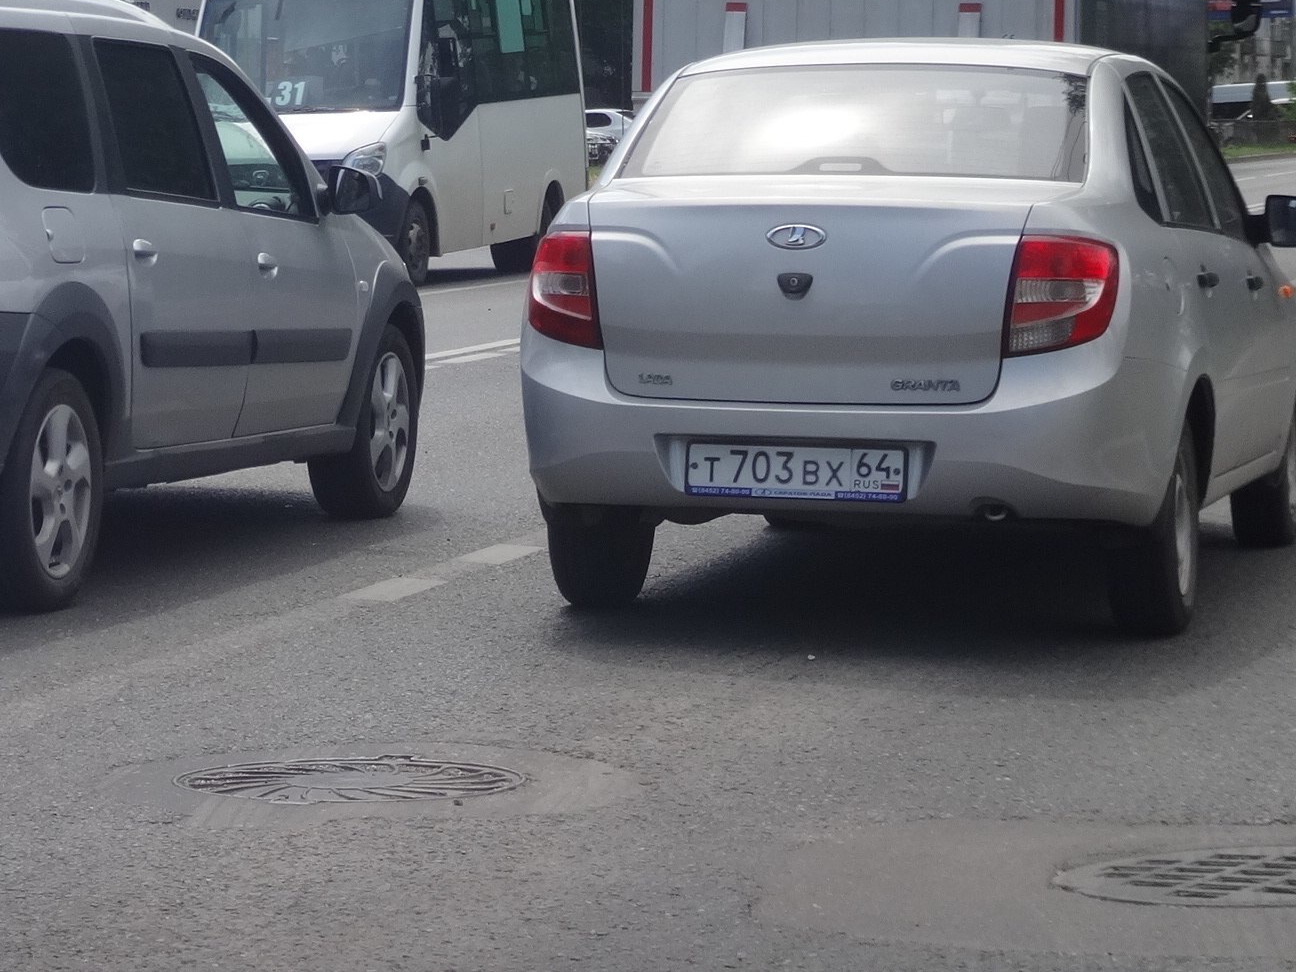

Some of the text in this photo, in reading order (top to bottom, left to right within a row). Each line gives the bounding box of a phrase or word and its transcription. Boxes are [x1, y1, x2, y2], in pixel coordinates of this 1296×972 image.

[890, 379, 961, 392] GRANTA
[855, 452, 891, 479] 64
[854, 479, 880, 490] RUS
